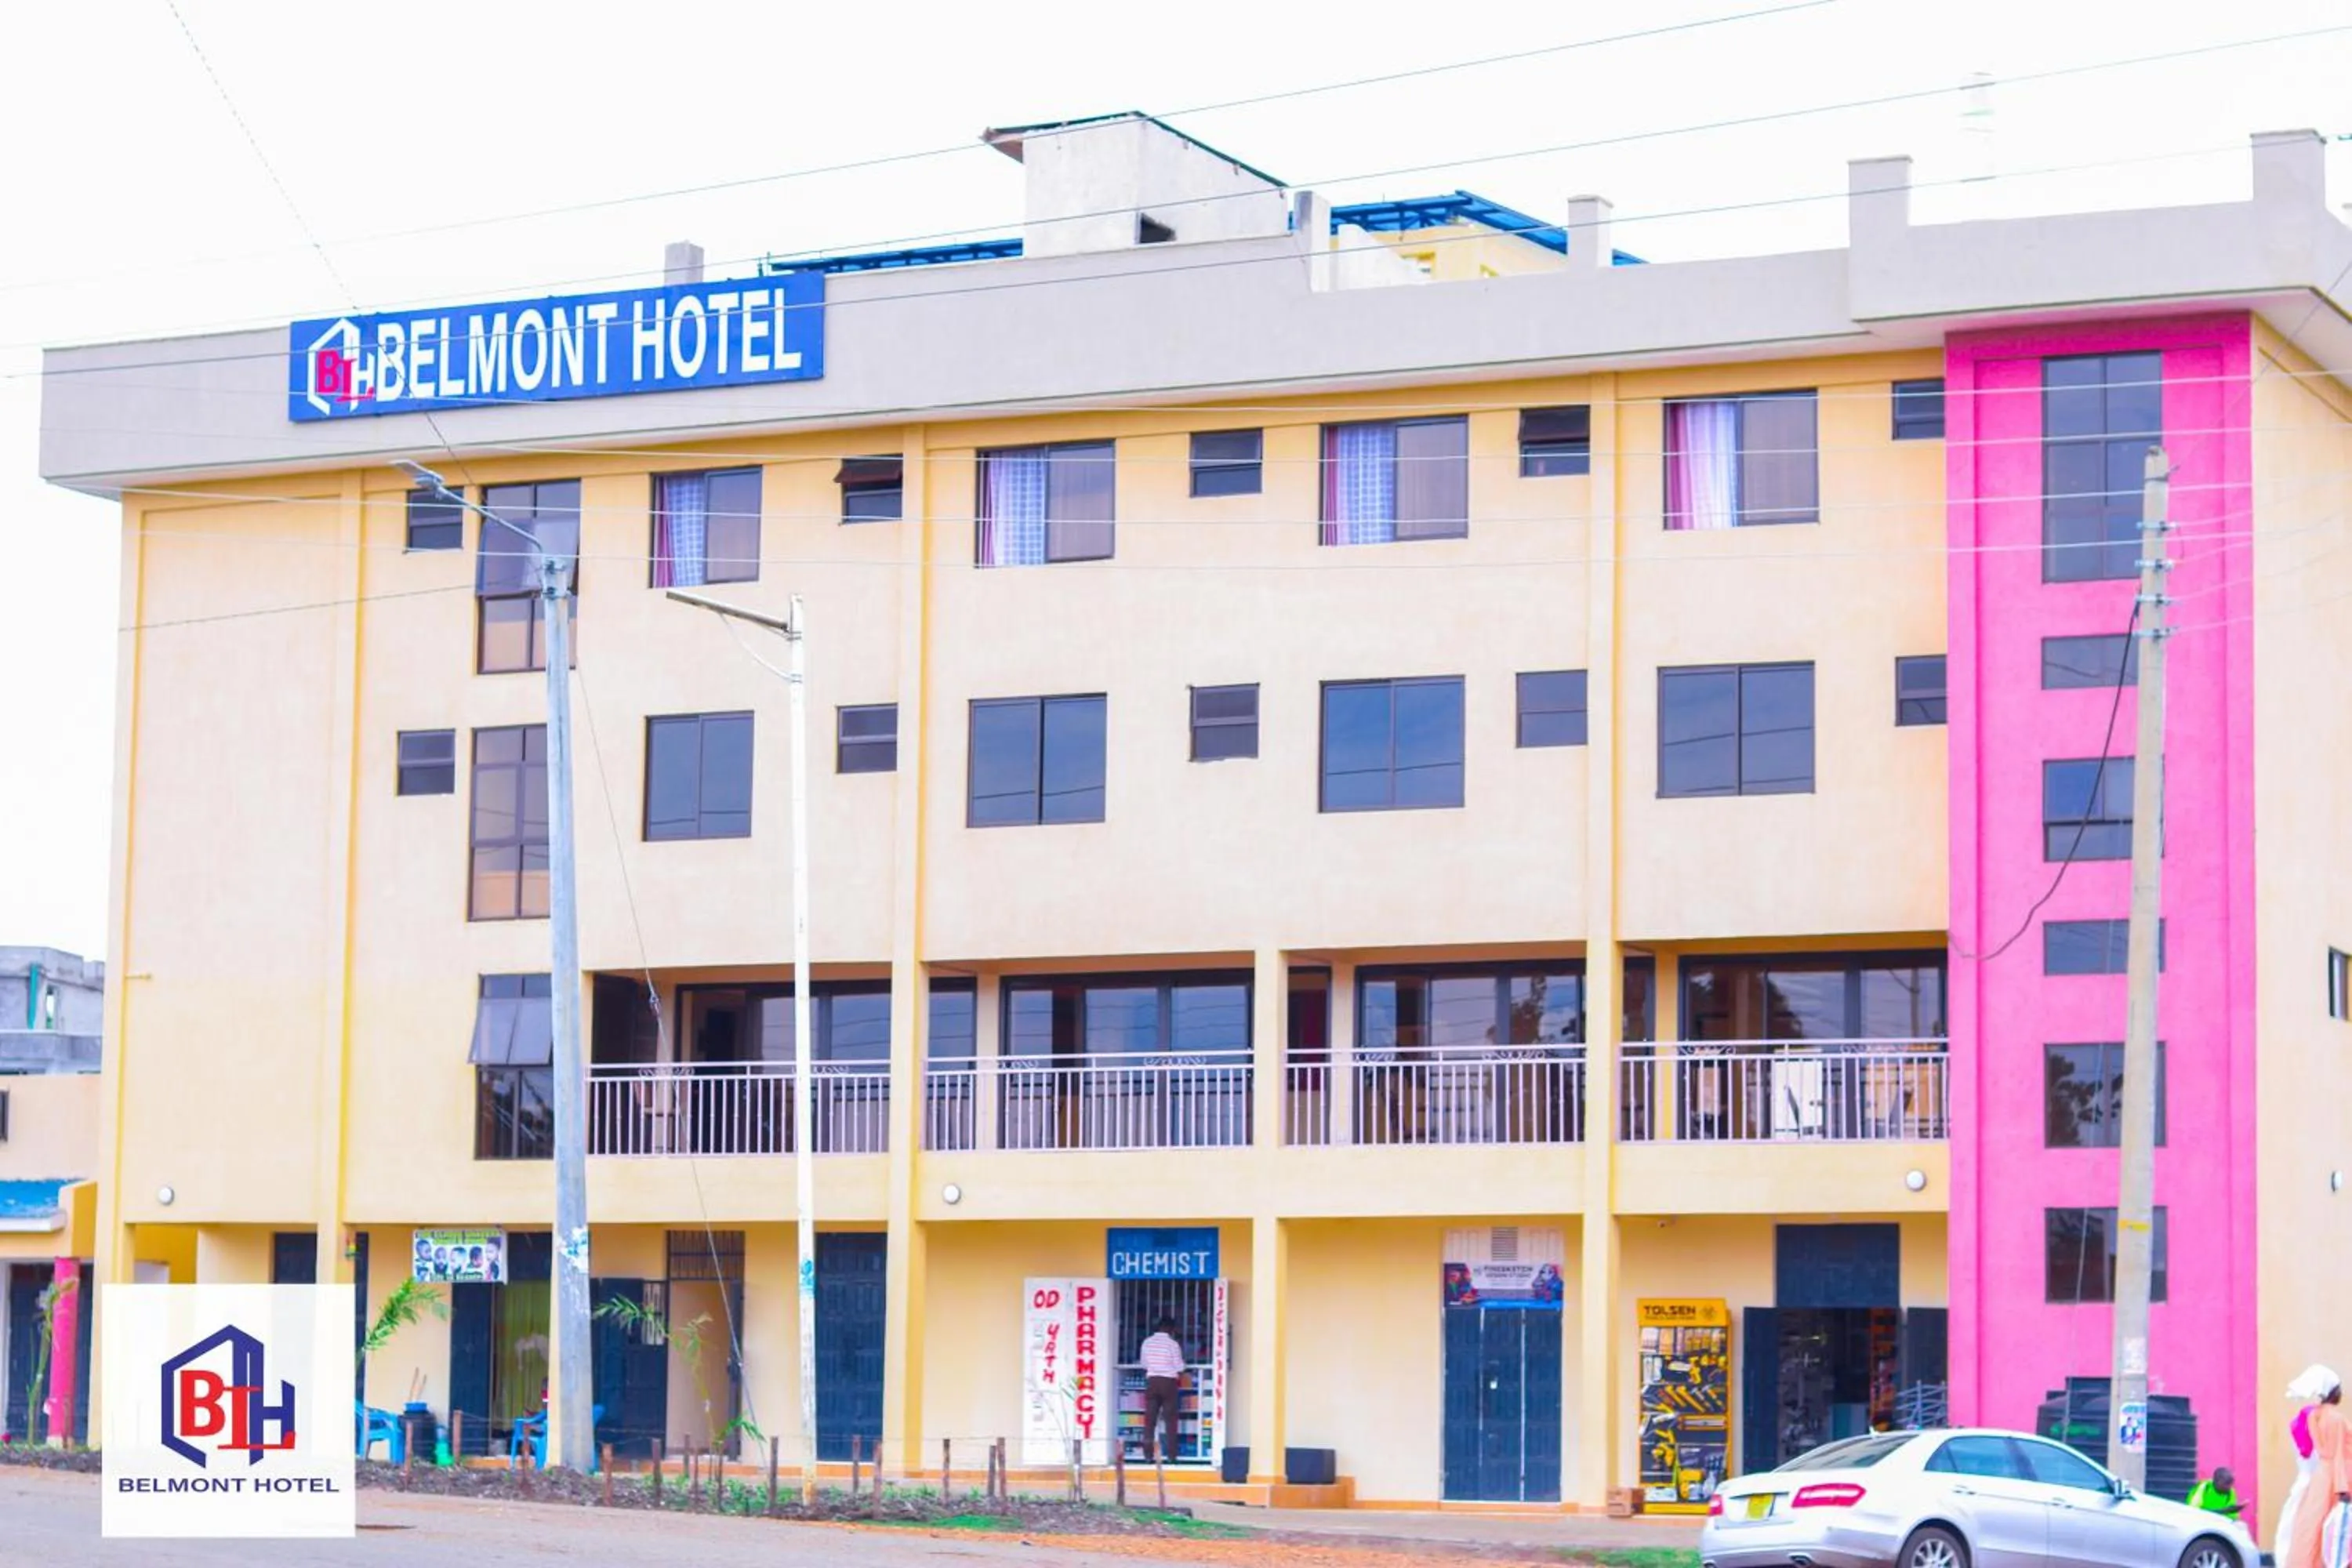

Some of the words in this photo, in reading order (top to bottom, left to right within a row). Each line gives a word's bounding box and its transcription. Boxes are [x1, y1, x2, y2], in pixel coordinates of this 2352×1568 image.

[377, 300, 619, 402] BELMONT
[632, 288, 802, 383] HOTEL
[1112, 1251, 1210, 1276] CHEMIST
[1643, 1305, 1696, 1315] TOLSEN
[1076, 1287, 1097, 1439] PHARMACY
